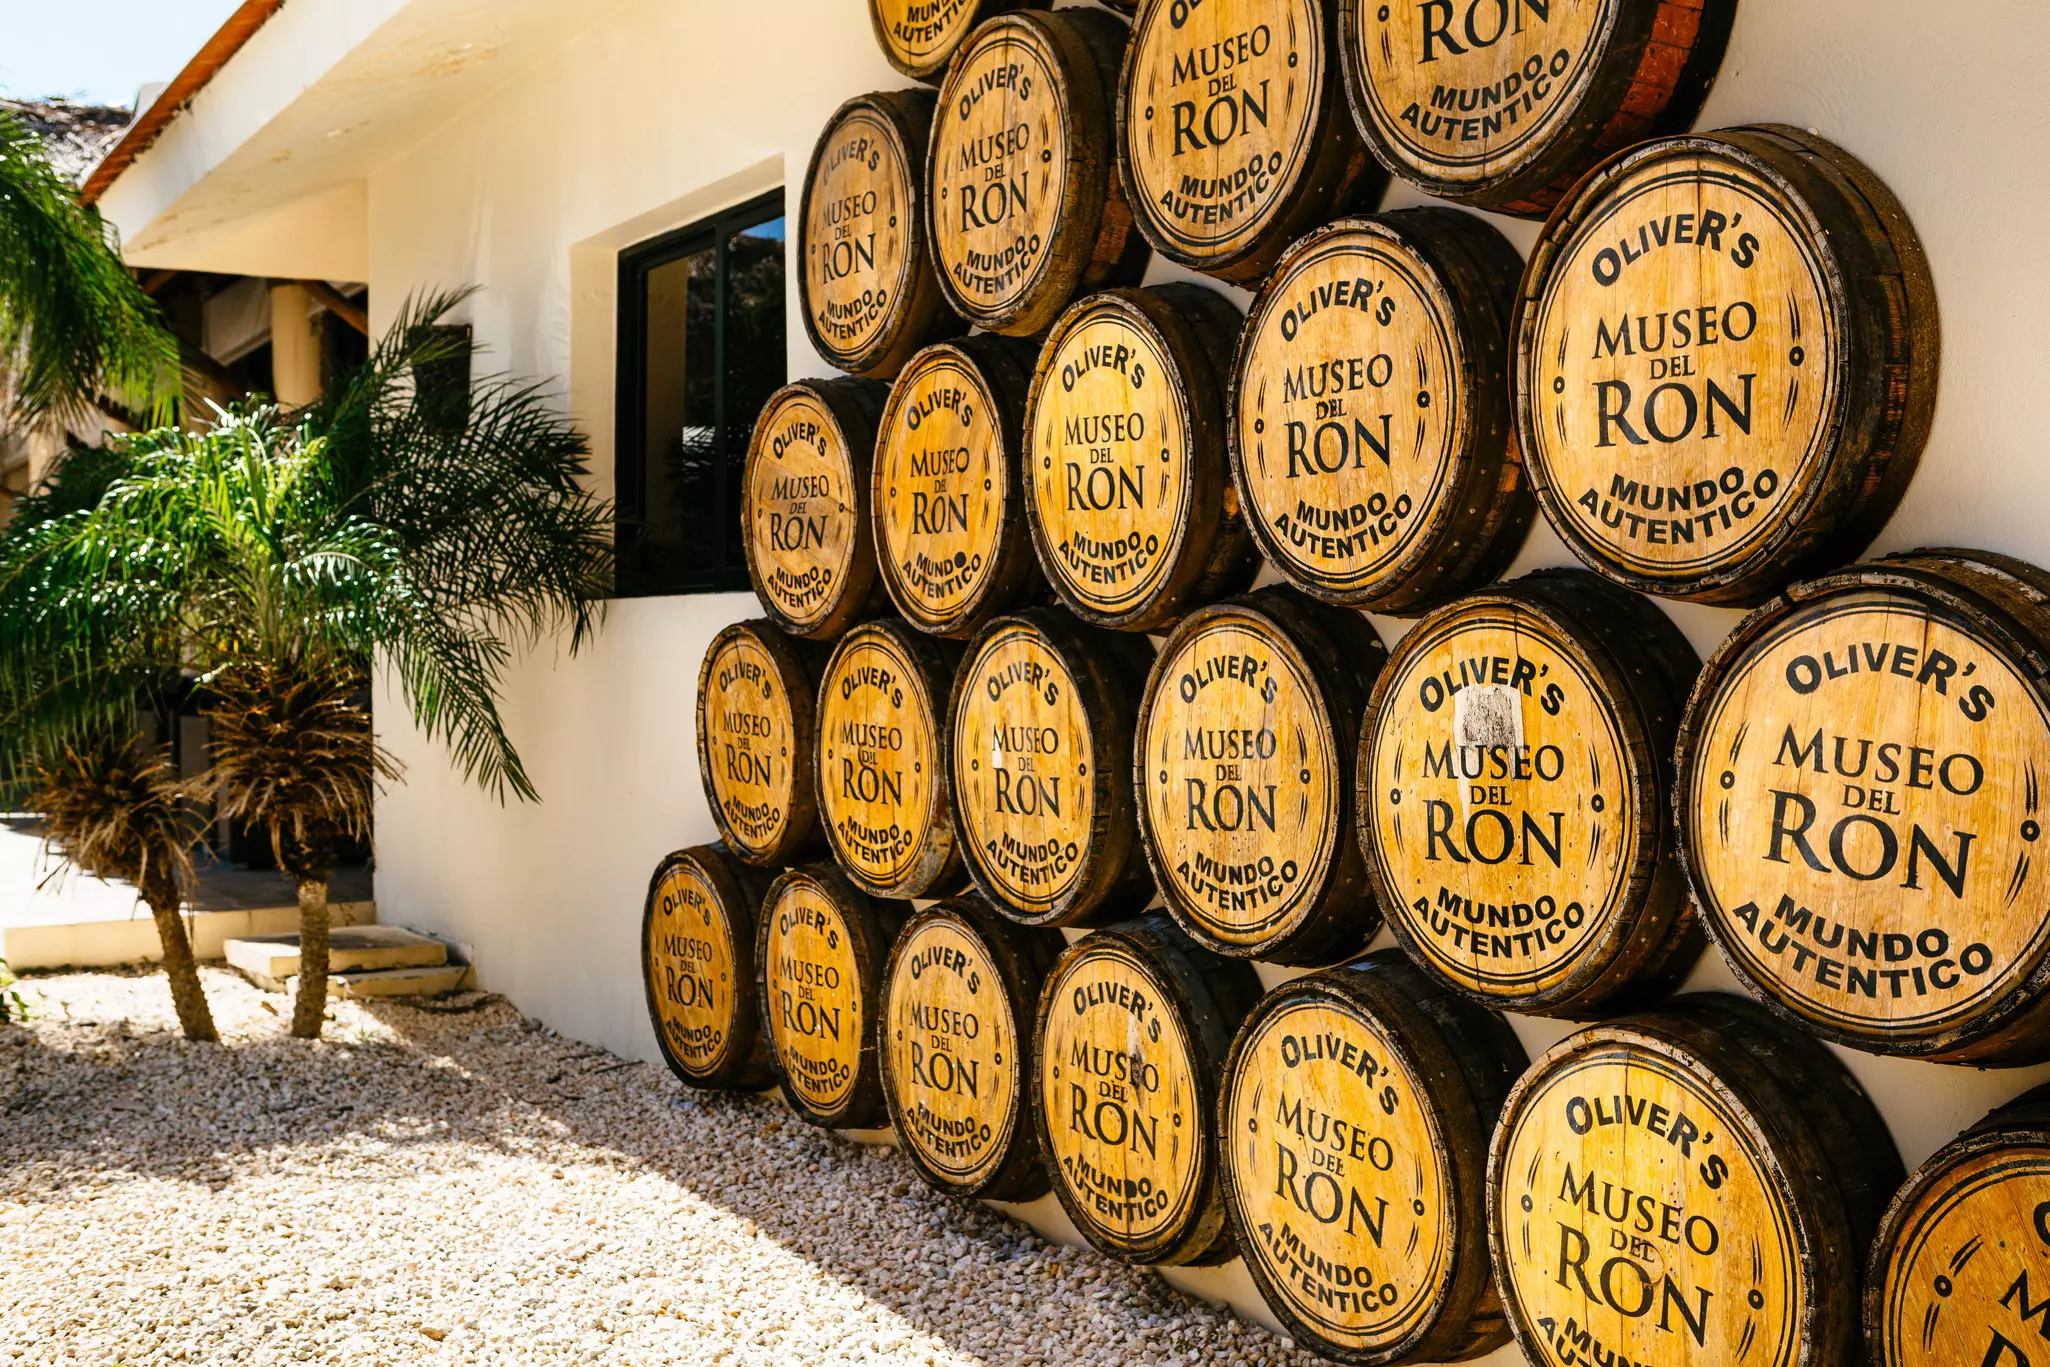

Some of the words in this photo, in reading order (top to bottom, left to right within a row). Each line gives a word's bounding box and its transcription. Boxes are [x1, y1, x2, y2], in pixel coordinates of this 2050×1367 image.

[1170, 24, 1271, 88] MUSEO
[959, 64, 1032, 121] OLIVER'S
[1207, 73, 1237, 97] DEL
[1400, 48, 1570, 142] AUTENTICO
[1429, 54, 1544, 112] MUNDO
[1171, 79, 1270, 157] RON
[822, 137, 881, 186] OLIVER'S
[959, 122, 1030, 172] MUSEO
[984, 164, 1006, 183] DEL
[1159, 150, 1283, 225] AUTENTICO
[1179, 153, 1263, 199] MUNDO
[821, 190, 877, 232] MUSEO
[960, 171, 1030, 234] RON
[834, 225, 852, 240] DEL
[966, 235, 1025, 272] MUNDO
[1592, 208, 1760, 287] OLIVER'S
[822, 232, 876, 285] RON
[953, 233, 1041, 295] AUTENTICO
[818, 289, 887, 340] AUTENTICO
[826, 289, 872, 319] MUNDO
[1281, 277, 1396, 342] OLIVER'S
[1591, 301, 1757, 360] MUSEO
[1062, 343, 1145, 393] OLIVER'S
[1283, 354, 1393, 404] MUSEO
[1649, 355, 1696, 380] DEL
[907, 388, 973, 431] OLIVER'S
[1064, 412, 1145, 446] MUSEO
[1315, 398, 1347, 421] DEL
[1591, 373, 1757, 448] RON
[772, 421, 827, 460] OLIVER'S
[909, 447, 970, 478] MUSEO
[1089, 447, 1114, 464] DEL
[1284, 413, 1394, 479] RON
[771, 474, 830, 501] MUSEO
[789, 501, 807, 514] DEL
[934, 478, 947, 493] DEL
[1065, 462, 1145, 512] RON
[1577, 468, 1779, 545] AUTENTICO
[1609, 466, 1745, 512] MUNDO
[769, 512, 829, 552] RON
[911, 491, 969, 535] RON
[1274, 492, 1412, 560] AUTENTICO
[1296, 492, 1387, 532] MUNDO
[916, 551, 967, 578] MUNDO
[1058, 534, 1159, 584] AUTENTICO
[1073, 530, 1141, 561] MUNDO
[767, 568, 832, 608] AUTENTICO
[776, 566, 819, 590] MUNDO
[902, 553, 982, 599] AUTENTICO
[719, 661, 772, 700] OLIVER'S
[842, 666, 903, 710] OLIVER'S
[986, 660, 1059, 706] OLIVER'S
[1180, 654, 1278, 705] OLIVER'S
[1419, 654, 1565, 716] OLIVER'S
[1785, 642, 1995, 722] OLIVER'S
[723, 711, 771, 739] MUSEO
[737, 736, 752, 751] DEL
[841, 719, 903, 752] MUSEO
[991, 724, 1059, 756] MUSEO
[1183, 726, 1277, 761] MUSEO
[725, 743, 772, 788] RON
[842, 757, 903, 808] RON
[1018, 756, 1035, 773] DEL
[1215, 764, 1242, 782] DEL
[1421, 739, 1564, 782] MUSEO
[1772, 723, 1984, 797] MUSEO
[732, 795, 769, 822] MUNDO
[992, 767, 1060, 818] RON
[1185, 777, 1278, 833] RON
[1470, 785, 1512, 806] DEL
[1841, 784, 1900, 816] DEL
[723, 800, 780, 840] AUTENTICO
[847, 815, 900, 845] MUNDO
[1423, 798, 1565, 869] RON
[837, 821, 913, 865] AUTENTICO
[985, 839, 1078, 886] AUTENTICO
[1001, 831, 1060, 863] MUNDO
[1762, 788, 1977, 899] RON
[1176, 859, 1298, 912] AUTENTICO
[1195, 851, 1274, 886] MUNDO
[663, 887, 711, 927] OLIVER'S
[779, 906, 839, 950] OLIVER'S
[1412, 895, 1584, 959] AUTENTICO
[1437, 885, 1556, 928] MUNDO
[1773, 893, 1949, 962] MUNDO
[663, 932, 713, 963] MUSEO
[680, 959, 696, 974] DEL
[1732, 900, 1993, 999] AUTENTICO
[665, 964, 714, 1012] RON
[779, 955, 840, 990] MUSEO
[798, 985, 815, 1001] DEL
[910, 945, 981, 996] OLIVER'S
[672, 1016, 711, 1043] MUNDO
[781, 989, 841, 1043] RON
[909, 1000, 979, 1040] MUSEO
[1073, 981, 1162, 1044] OLIVER'S
[789, 1045, 838, 1077] MUNDO
[930, 1034, 952, 1053] DEL
[783, 1049, 850, 1094] AUTENTICO
[910, 1039, 980, 1100] RON
[1098, 1080, 1129, 1102] DEL
[1280, 1034, 1399, 1117] OLIVER'S
[906, 1106, 991, 1159] AUTENTICO
[916, 1101, 976, 1138] MUNDO
[1069, 1081, 1159, 1162] RON
[1275, 1090, 1394, 1173] MUSEO
[1565, 1094, 1729, 1190] OLIVER'S
[1312, 1147, 1345, 1178] DEL
[1062, 1155, 1169, 1223] AUTENTICO
[1274, 1140, 1390, 1250] RON
[1557, 1161, 1720, 1256] MUSEO
[1257, 1221, 1398, 1314] AUTENTICO
[1280, 1221, 1373, 1289] MUNDO
[1609, 1227, 1655, 1263] DEL
[1554, 1221, 1714, 1348] RON
